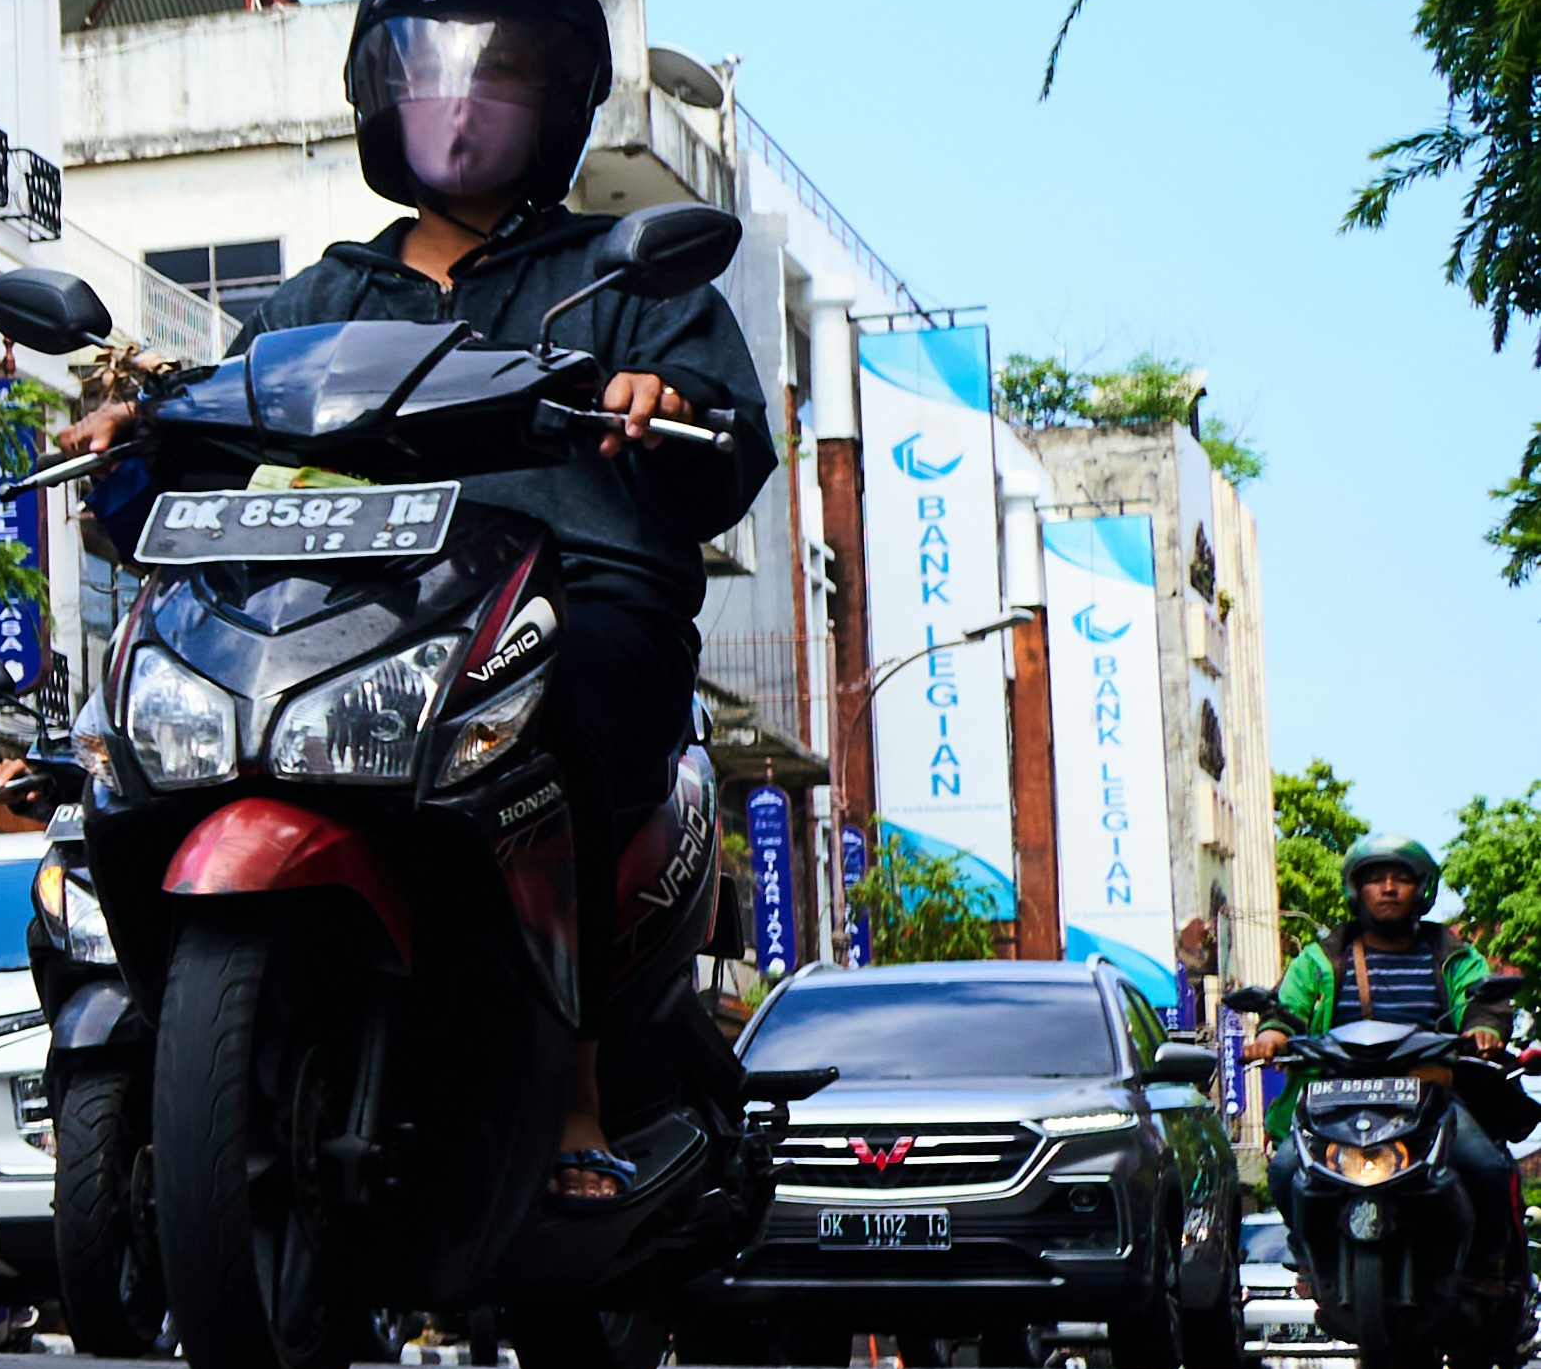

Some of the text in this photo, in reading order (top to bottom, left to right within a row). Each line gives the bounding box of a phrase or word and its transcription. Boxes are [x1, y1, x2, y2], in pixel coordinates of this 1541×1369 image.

[163, 496, 229, 530] DK
[239, 496, 363, 528] 8592
[370, 530, 418, 548] 20
[466, 629, 541, 682] VARIO
[918, 496, 961, 798] BANK LEGIAN
[498, 780, 563, 828] HONDA
[1094, 656, 1132, 906] BANK LEGIAN
[637, 804, 708, 909] VARIO
[820, 1214, 844, 1237] DK
[863, 1214, 907, 1237] 1102
